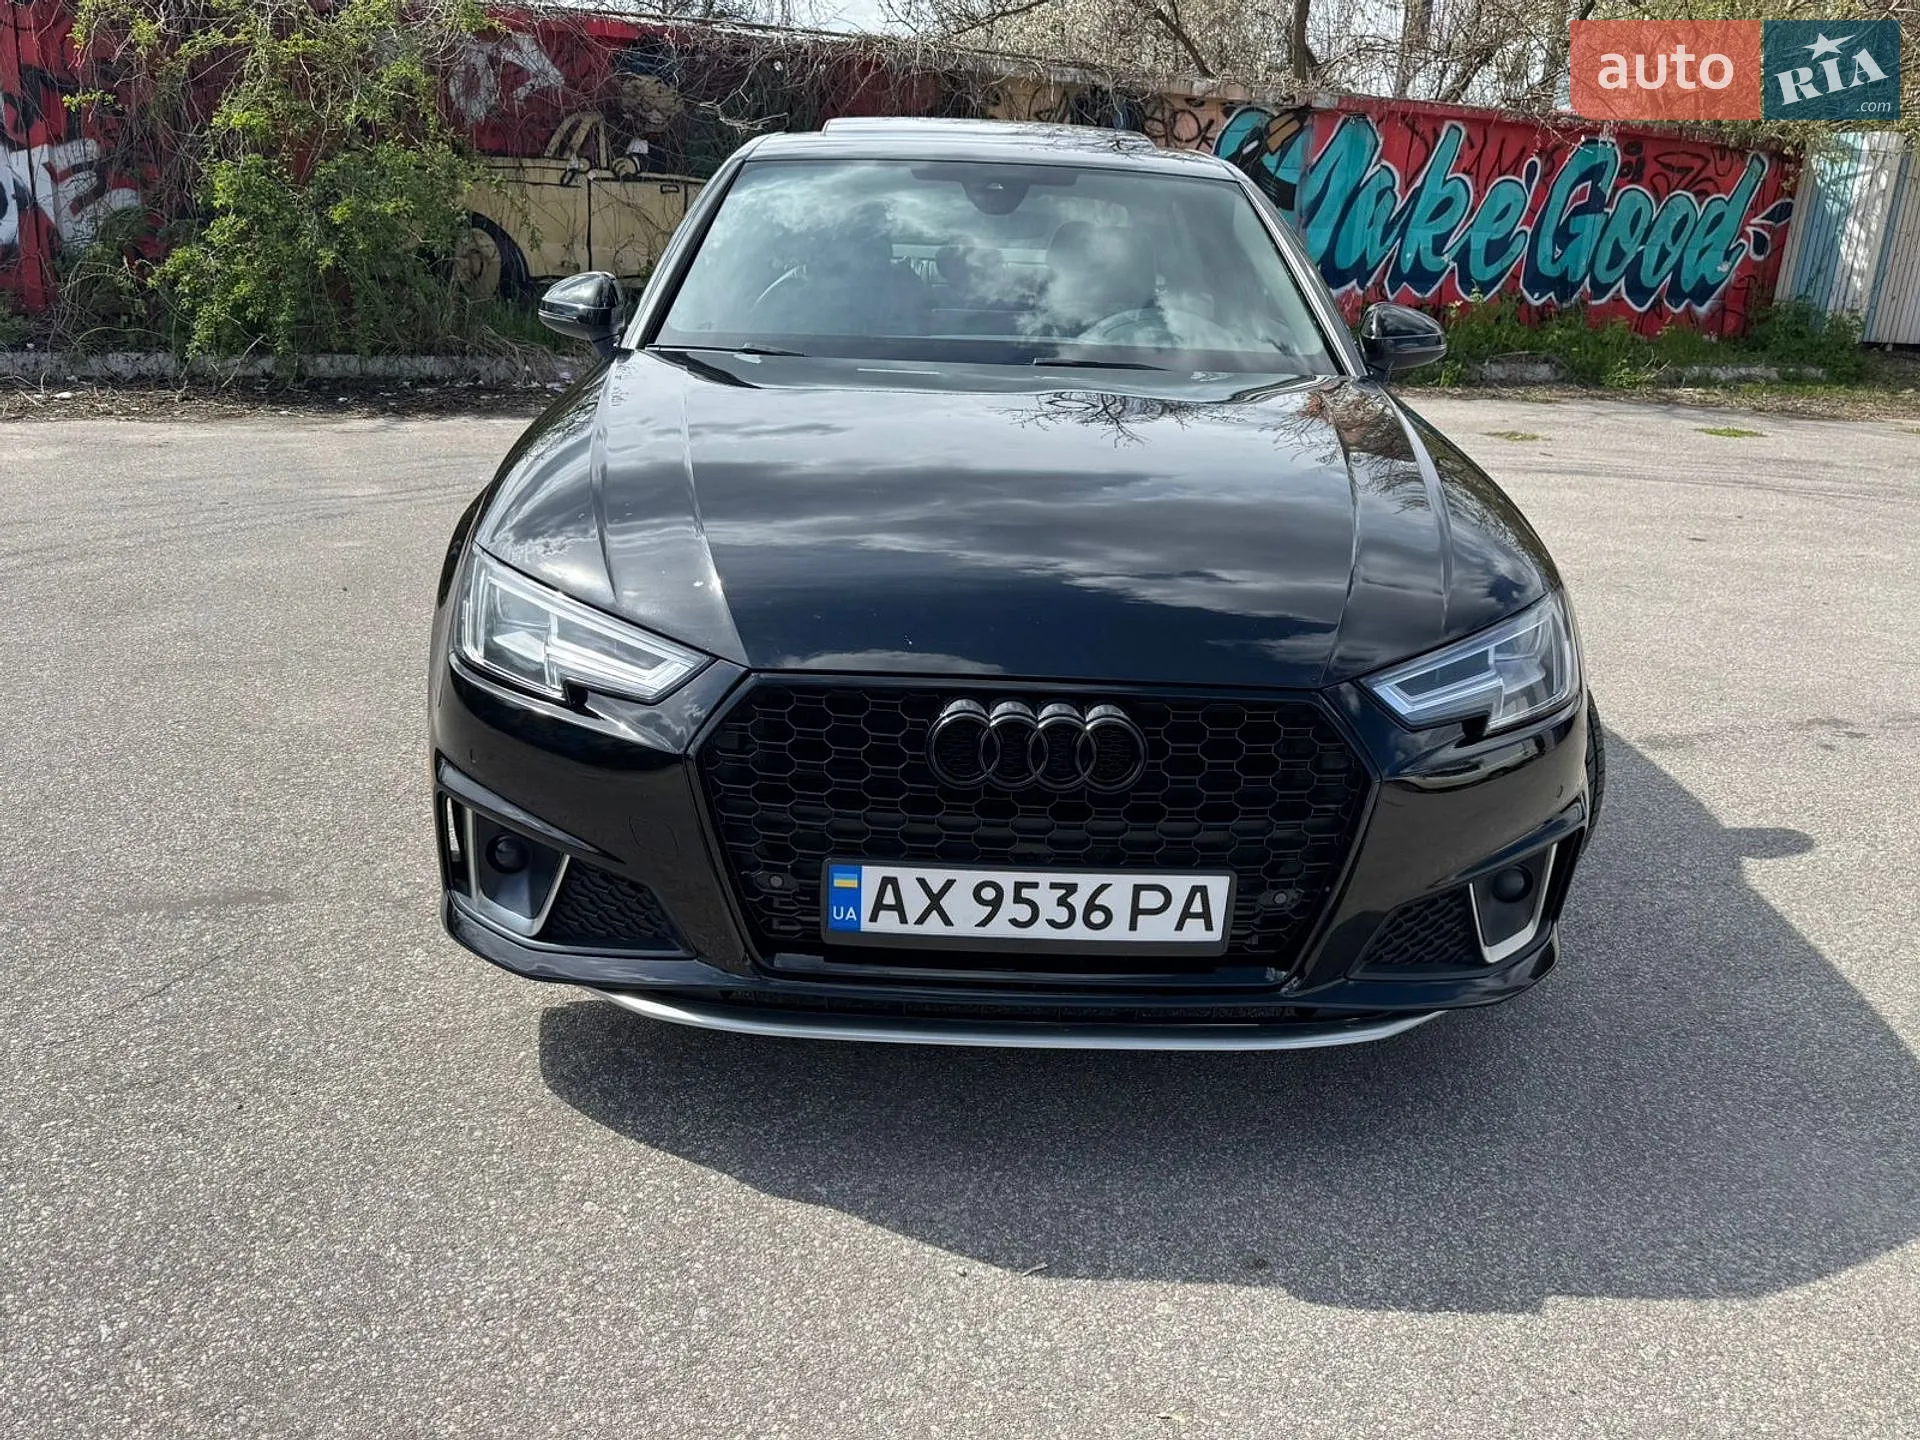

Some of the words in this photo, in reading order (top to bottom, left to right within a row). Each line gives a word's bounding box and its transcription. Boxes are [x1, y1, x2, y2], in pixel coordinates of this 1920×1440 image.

[1519, 136, 1768, 313] Good
[833, 905, 857, 921] UA
[868, 876, 957, 927] AX
[972, 880, 1114, 931] 9536
[1128, 884, 1214, 932] PA
